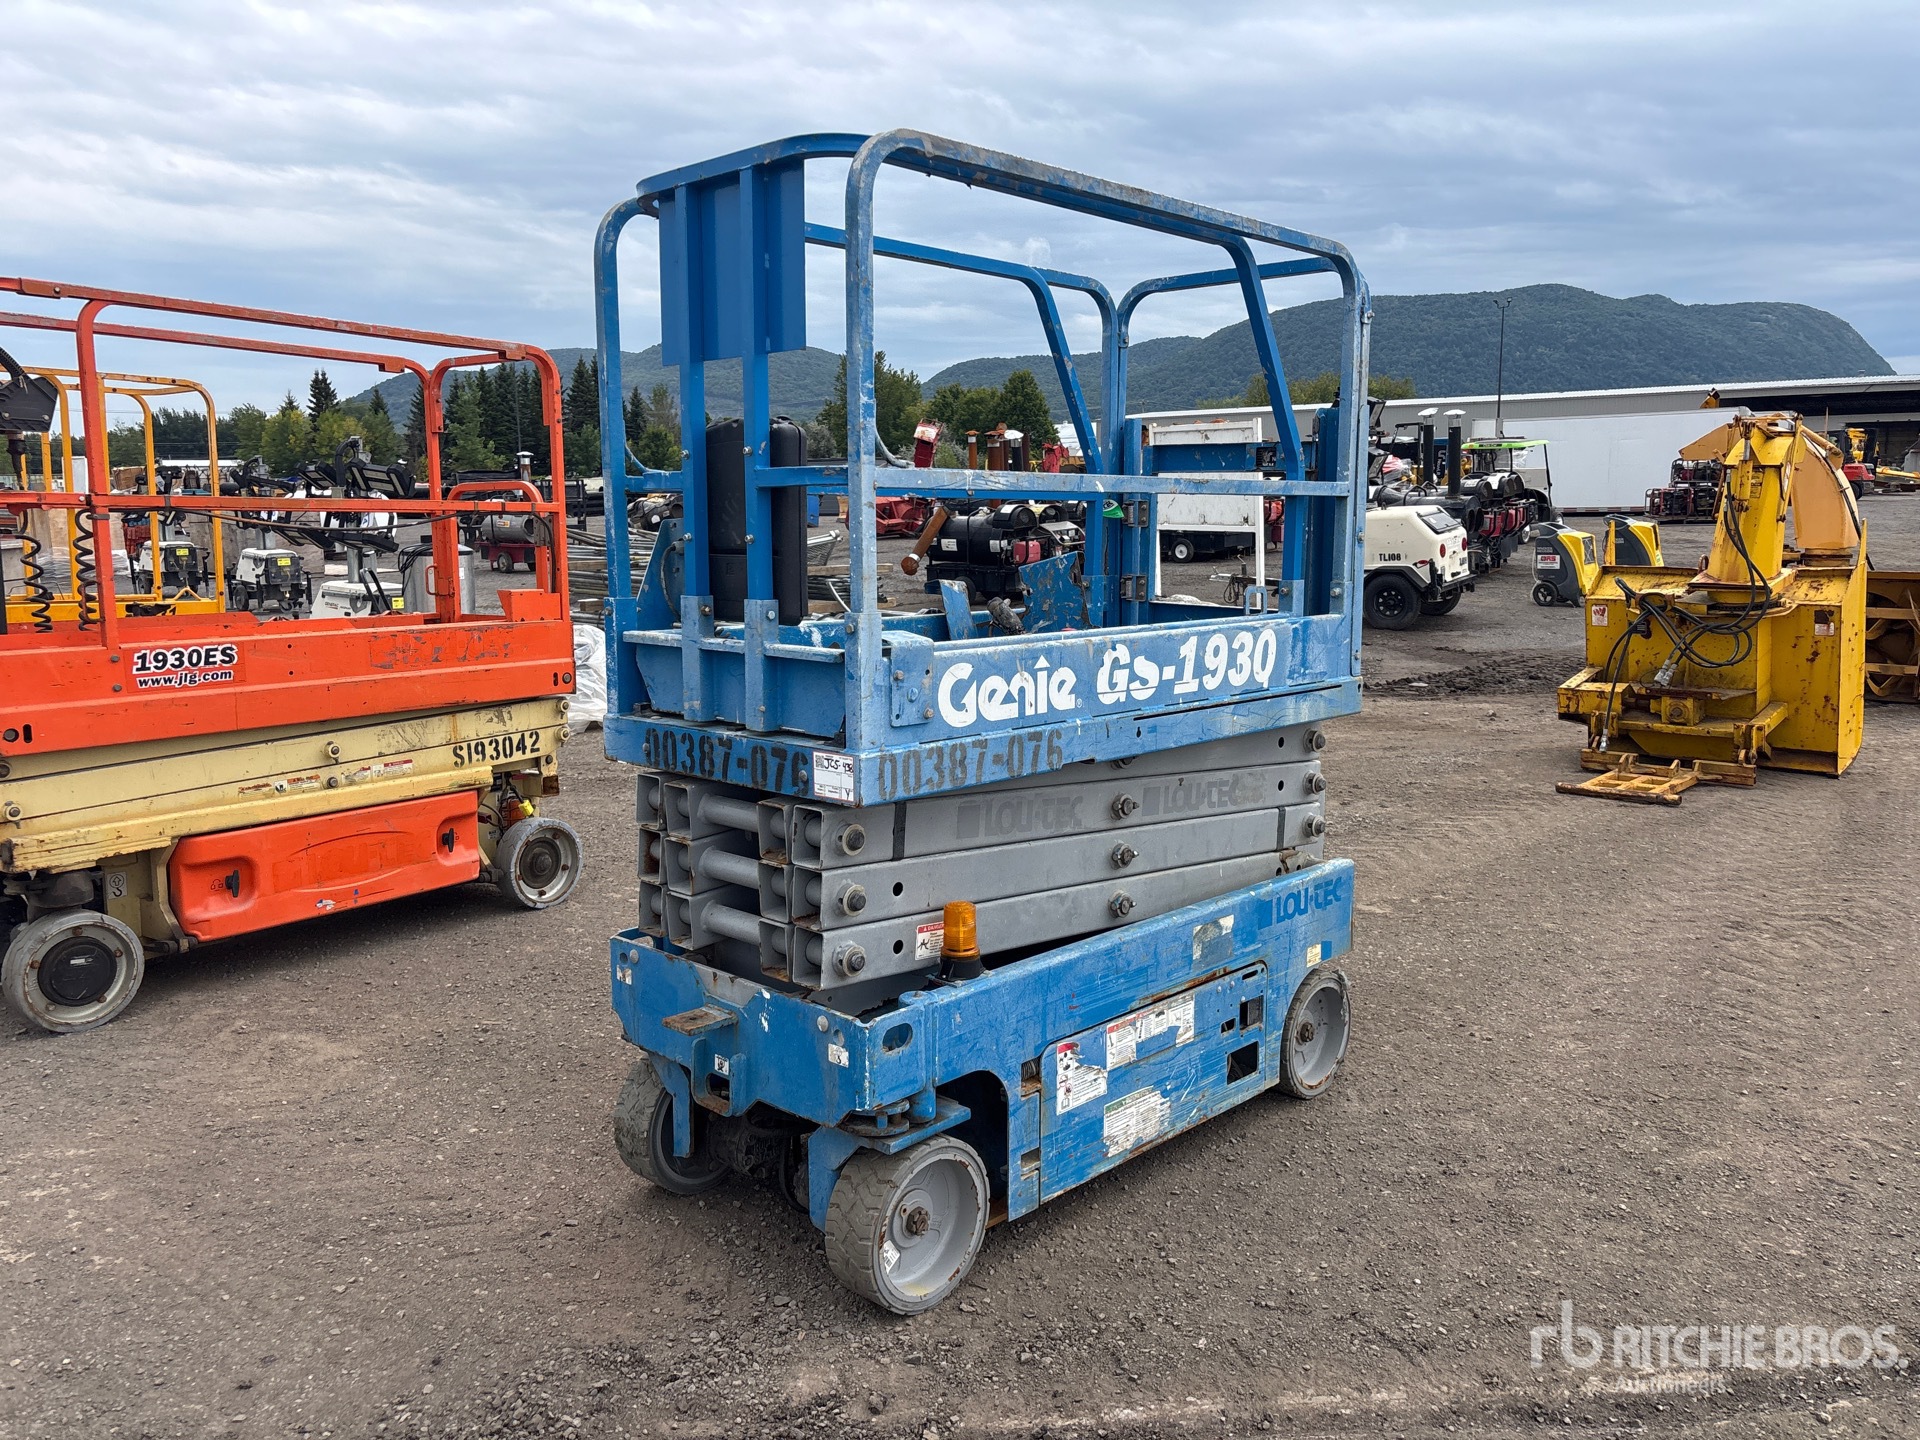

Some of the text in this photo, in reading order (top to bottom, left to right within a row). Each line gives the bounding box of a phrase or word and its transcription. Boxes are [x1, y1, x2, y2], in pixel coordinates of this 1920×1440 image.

[1379, 553, 1401, 561] TL108
[133, 644, 238, 673] 1930ES
[137, 670, 233, 688] www.jlg.com
[937, 654, 1077, 728] Genie
[644, 727, 809, 796] 00387-076
[878, 729, 1063, 800] 00387-076
